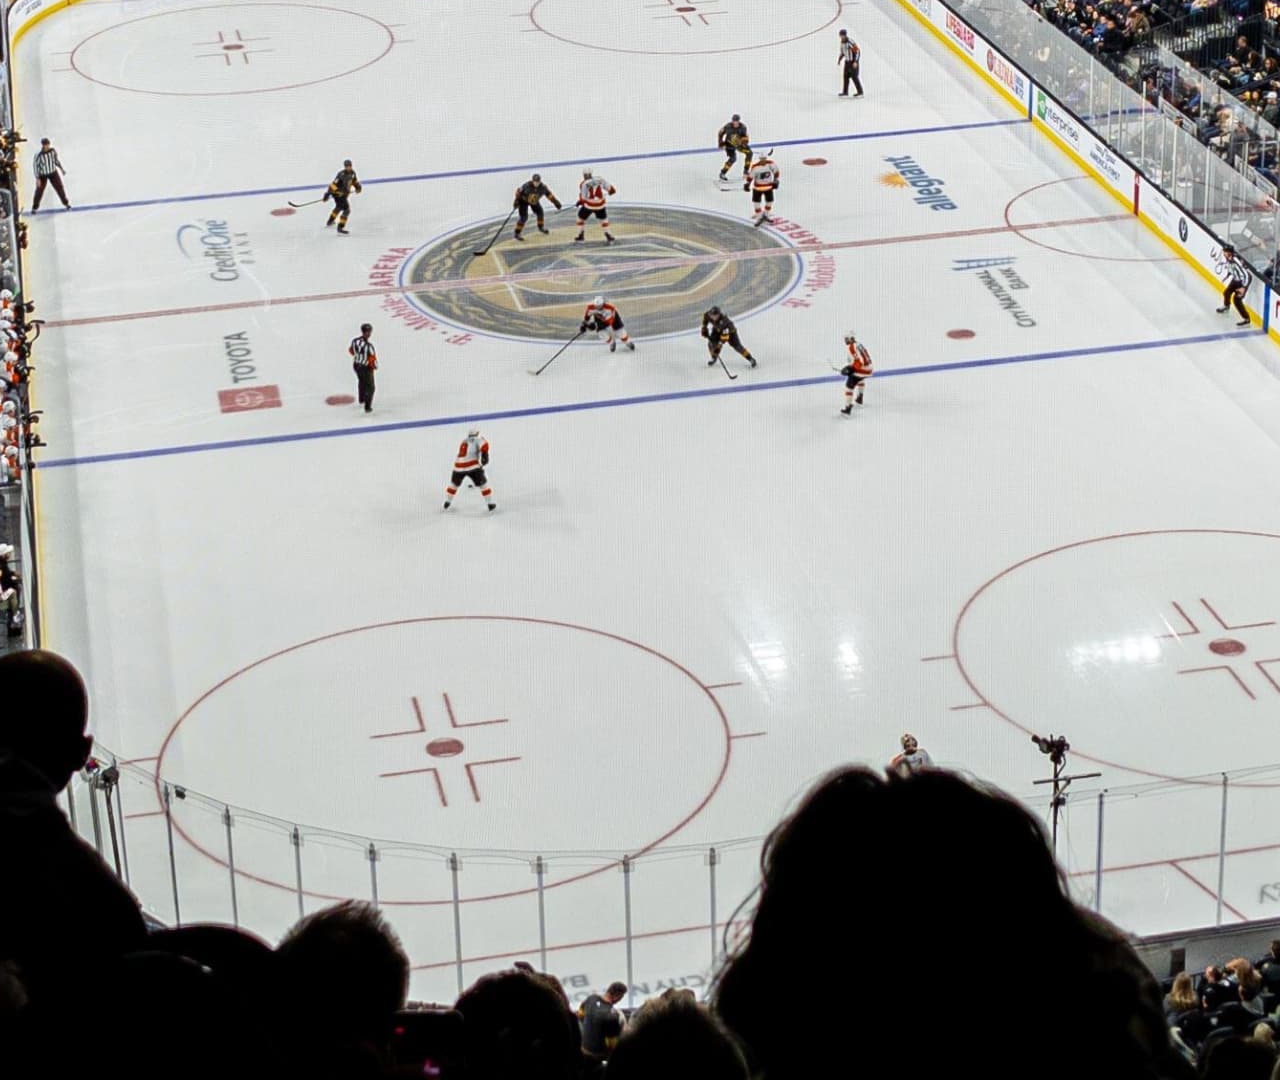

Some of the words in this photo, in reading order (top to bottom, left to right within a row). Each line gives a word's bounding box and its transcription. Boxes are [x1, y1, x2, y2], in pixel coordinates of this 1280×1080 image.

[587, 184, 603, 200] 14
[883, 155, 958, 211] allegiant
[200, 219, 239, 281] CreditOne
[368, 247, 413, 287] ARENA
[224, 330, 257, 383] TOYOTA
